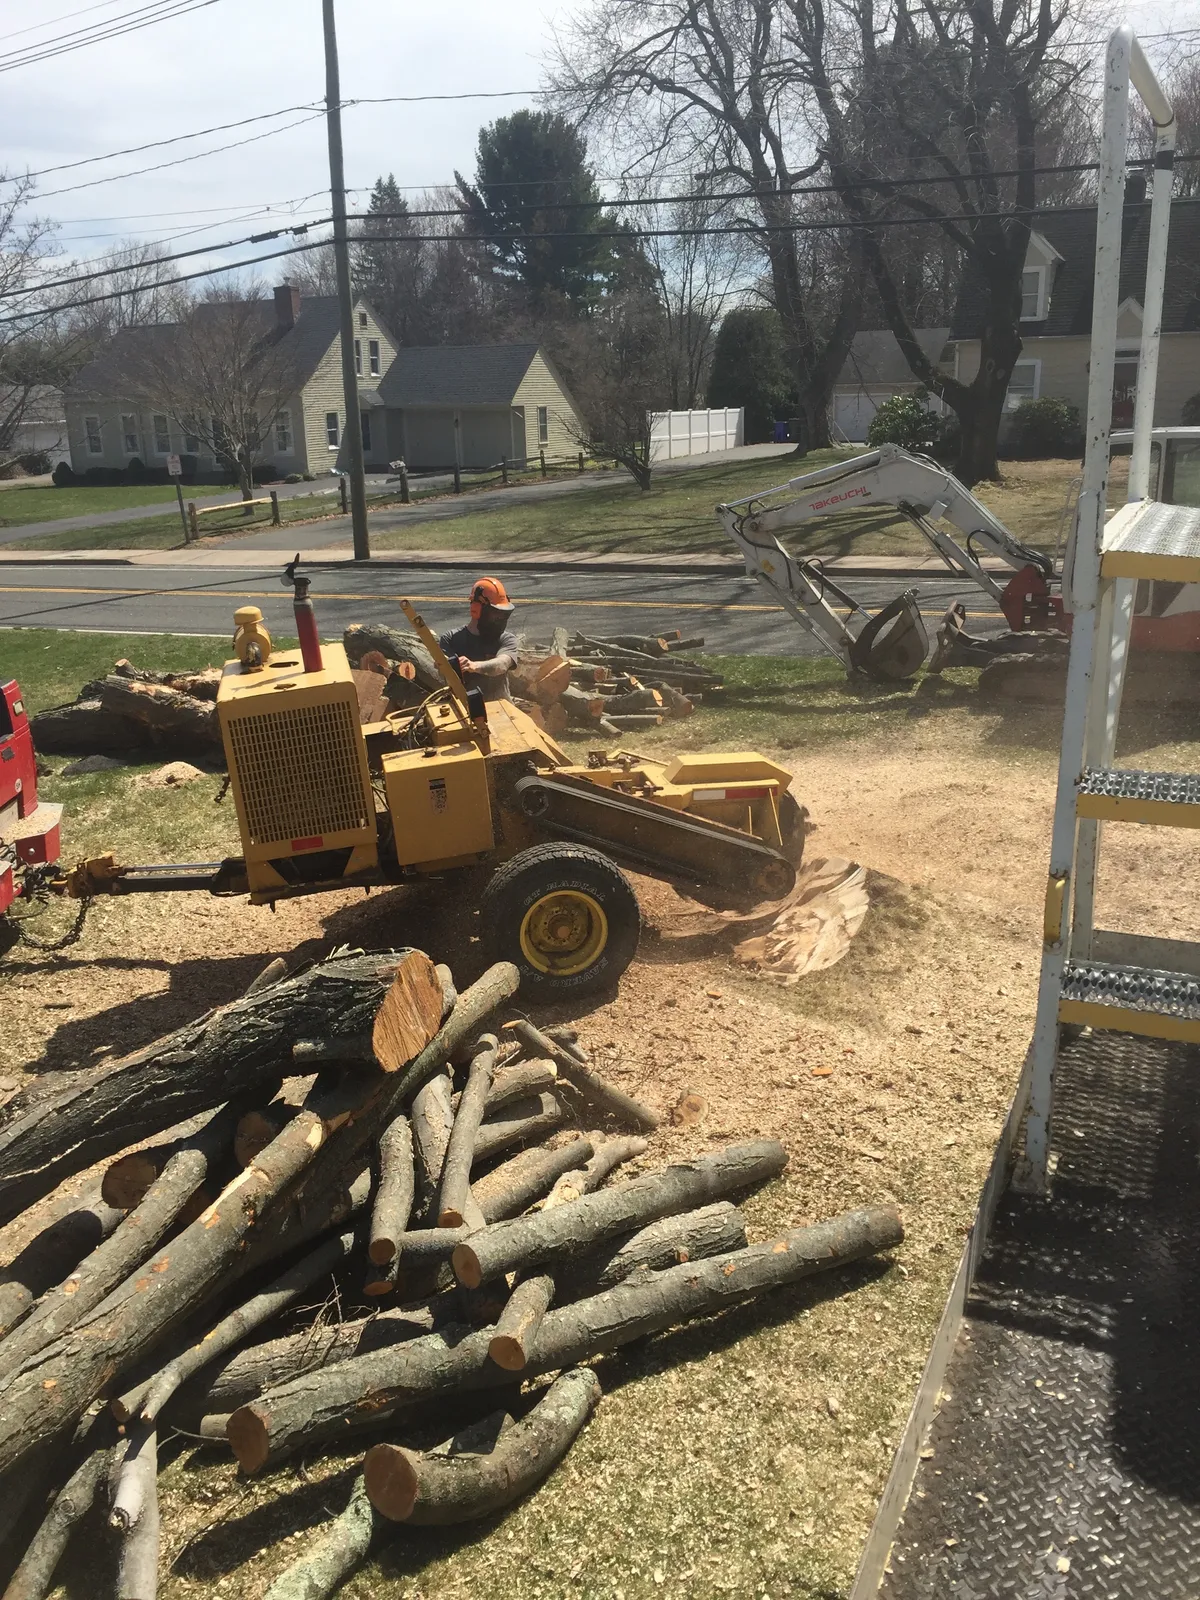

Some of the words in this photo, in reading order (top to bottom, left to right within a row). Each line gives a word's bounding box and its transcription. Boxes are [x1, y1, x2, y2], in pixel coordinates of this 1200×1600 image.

[808, 486, 867, 511] TAKEUCHI
[546, 880, 607, 902] RADIAL
[549, 957, 609, 988] SAVERO
